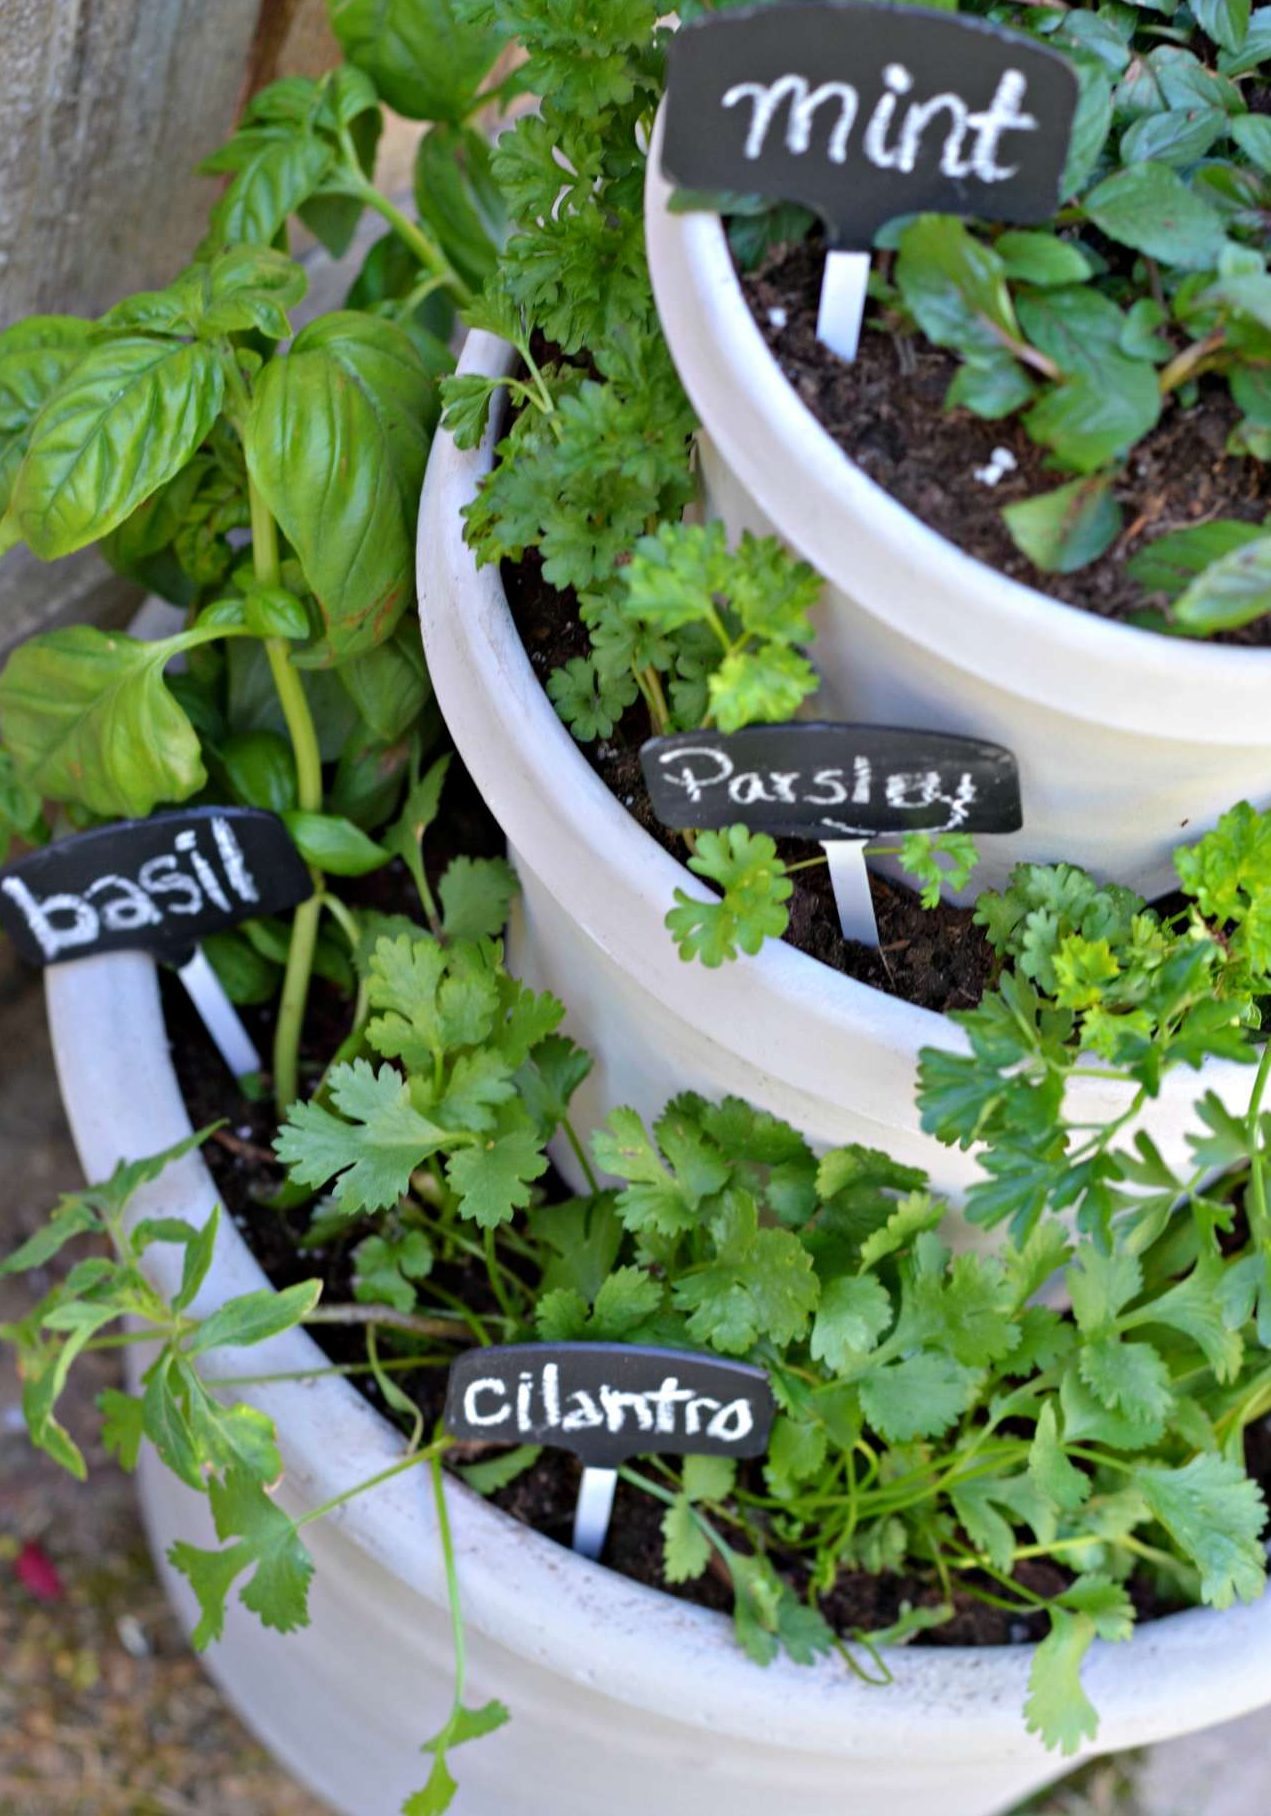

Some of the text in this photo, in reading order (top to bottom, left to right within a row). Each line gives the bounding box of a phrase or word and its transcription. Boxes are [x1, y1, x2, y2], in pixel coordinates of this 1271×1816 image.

[722, 63, 1039, 184] mint
[659, 746, 977, 837] Parsley
[1, 816, 260, 960] basil
